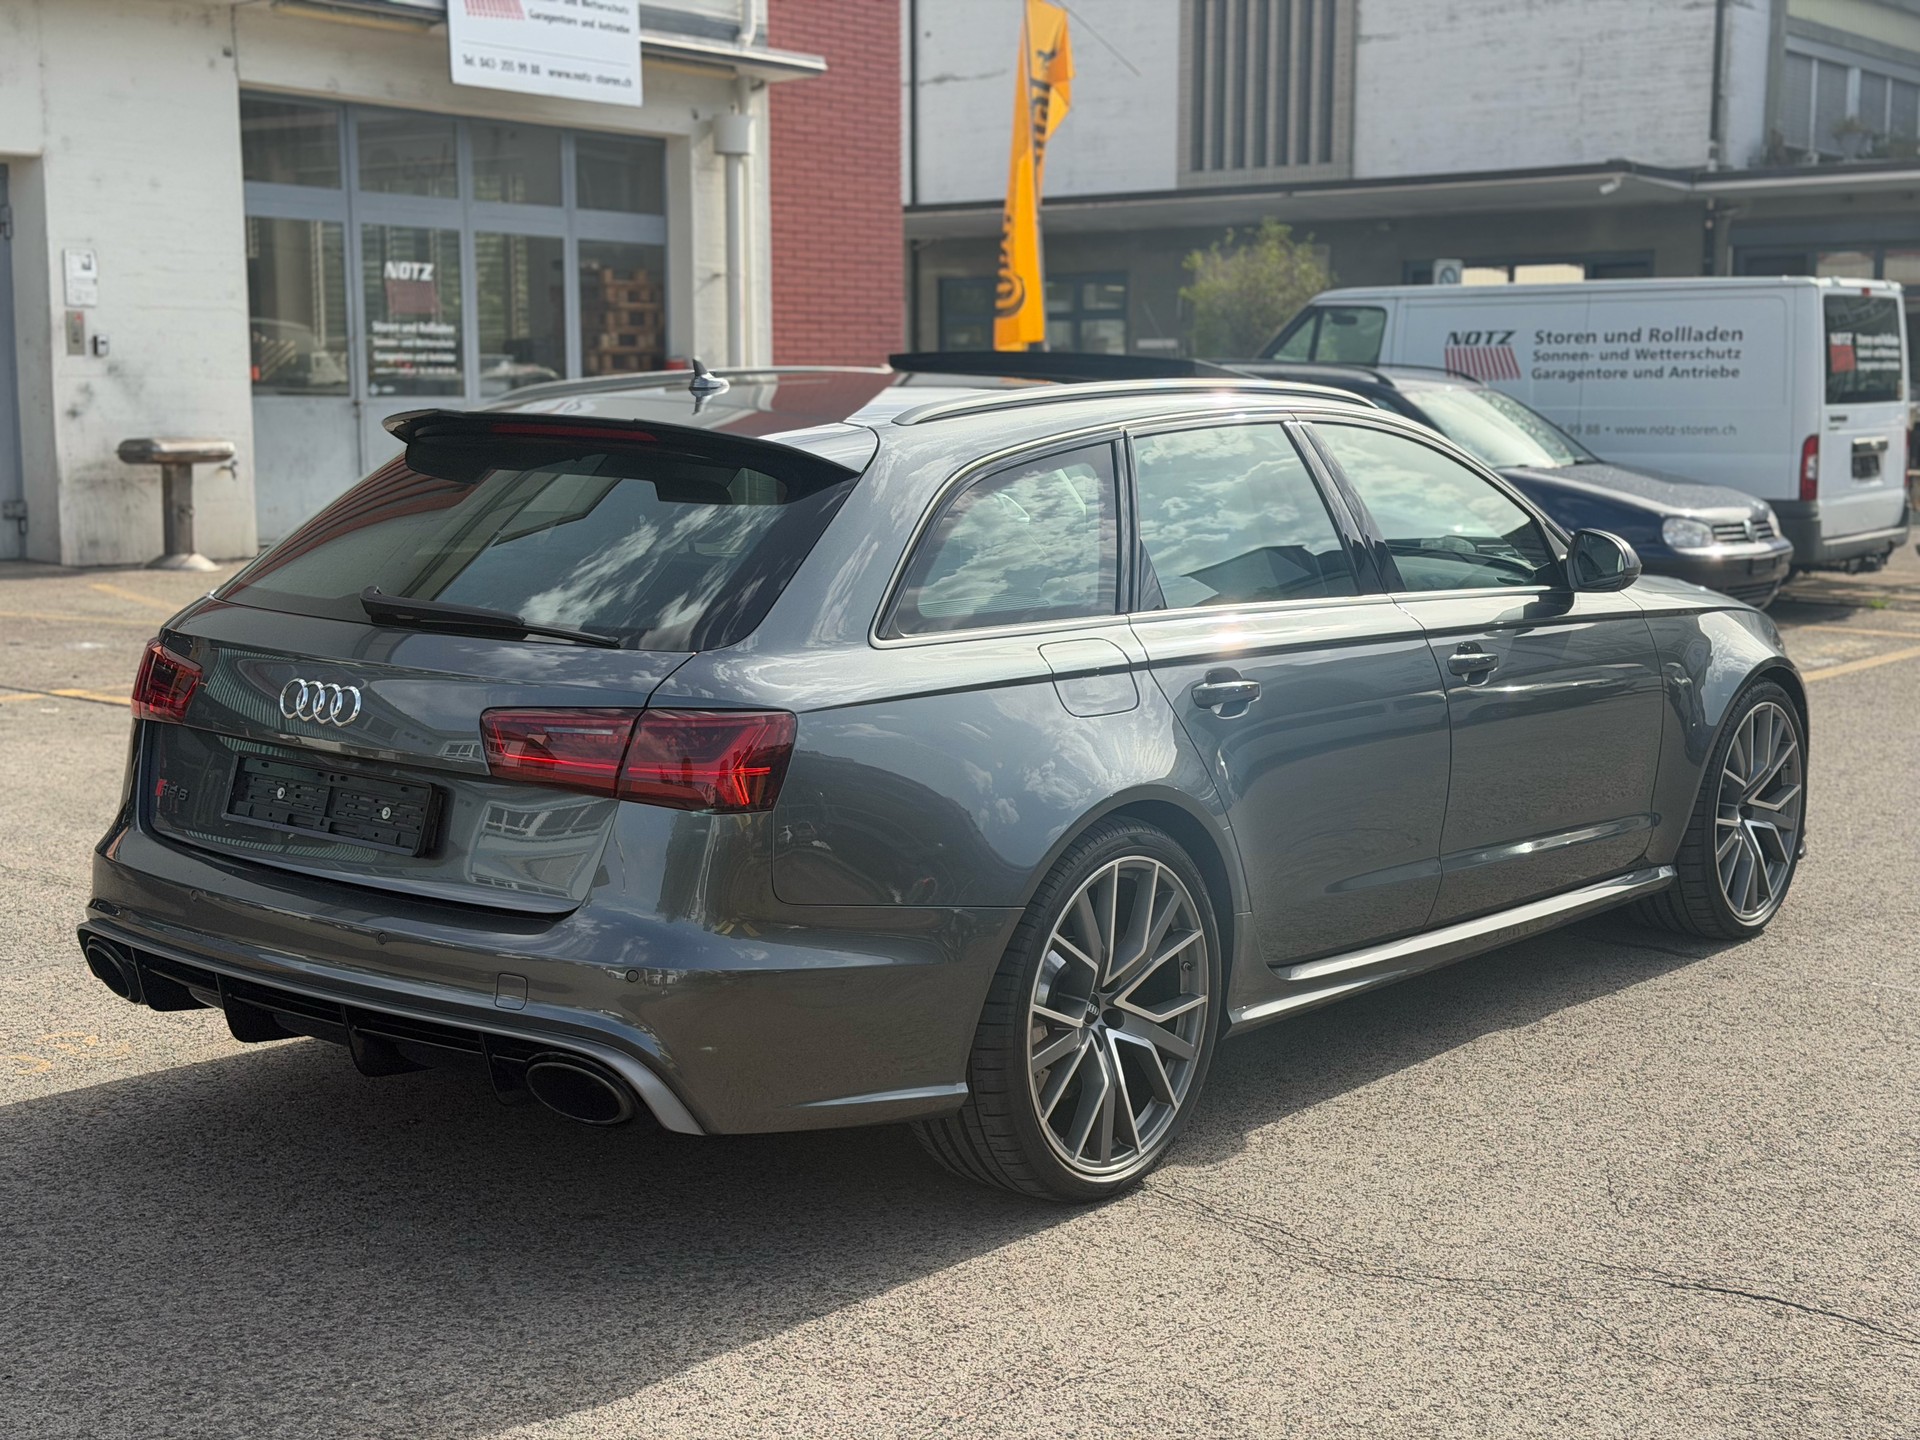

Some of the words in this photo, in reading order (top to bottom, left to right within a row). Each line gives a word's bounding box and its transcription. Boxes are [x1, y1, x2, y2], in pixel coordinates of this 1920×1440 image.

[383, 260, 435, 282] NOTZ
[1446, 329, 1517, 346] NOTZ
[1535, 329, 1597, 345] Storen
[1603, 326, 1642, 344] und
[1649, 325, 1744, 342] Rollladen
[1532, 349, 1595, 362] Sonnen-
[1599, 347, 1629, 361] und
[1634, 346, 1742, 361] Wetterschutz
[1531, 367, 1628, 384] Garagentore
[1633, 365, 1664, 379] und
[1668, 364, 1740, 379] Antriebe
[1614, 422, 1737, 437] www.notz-storen.ch
